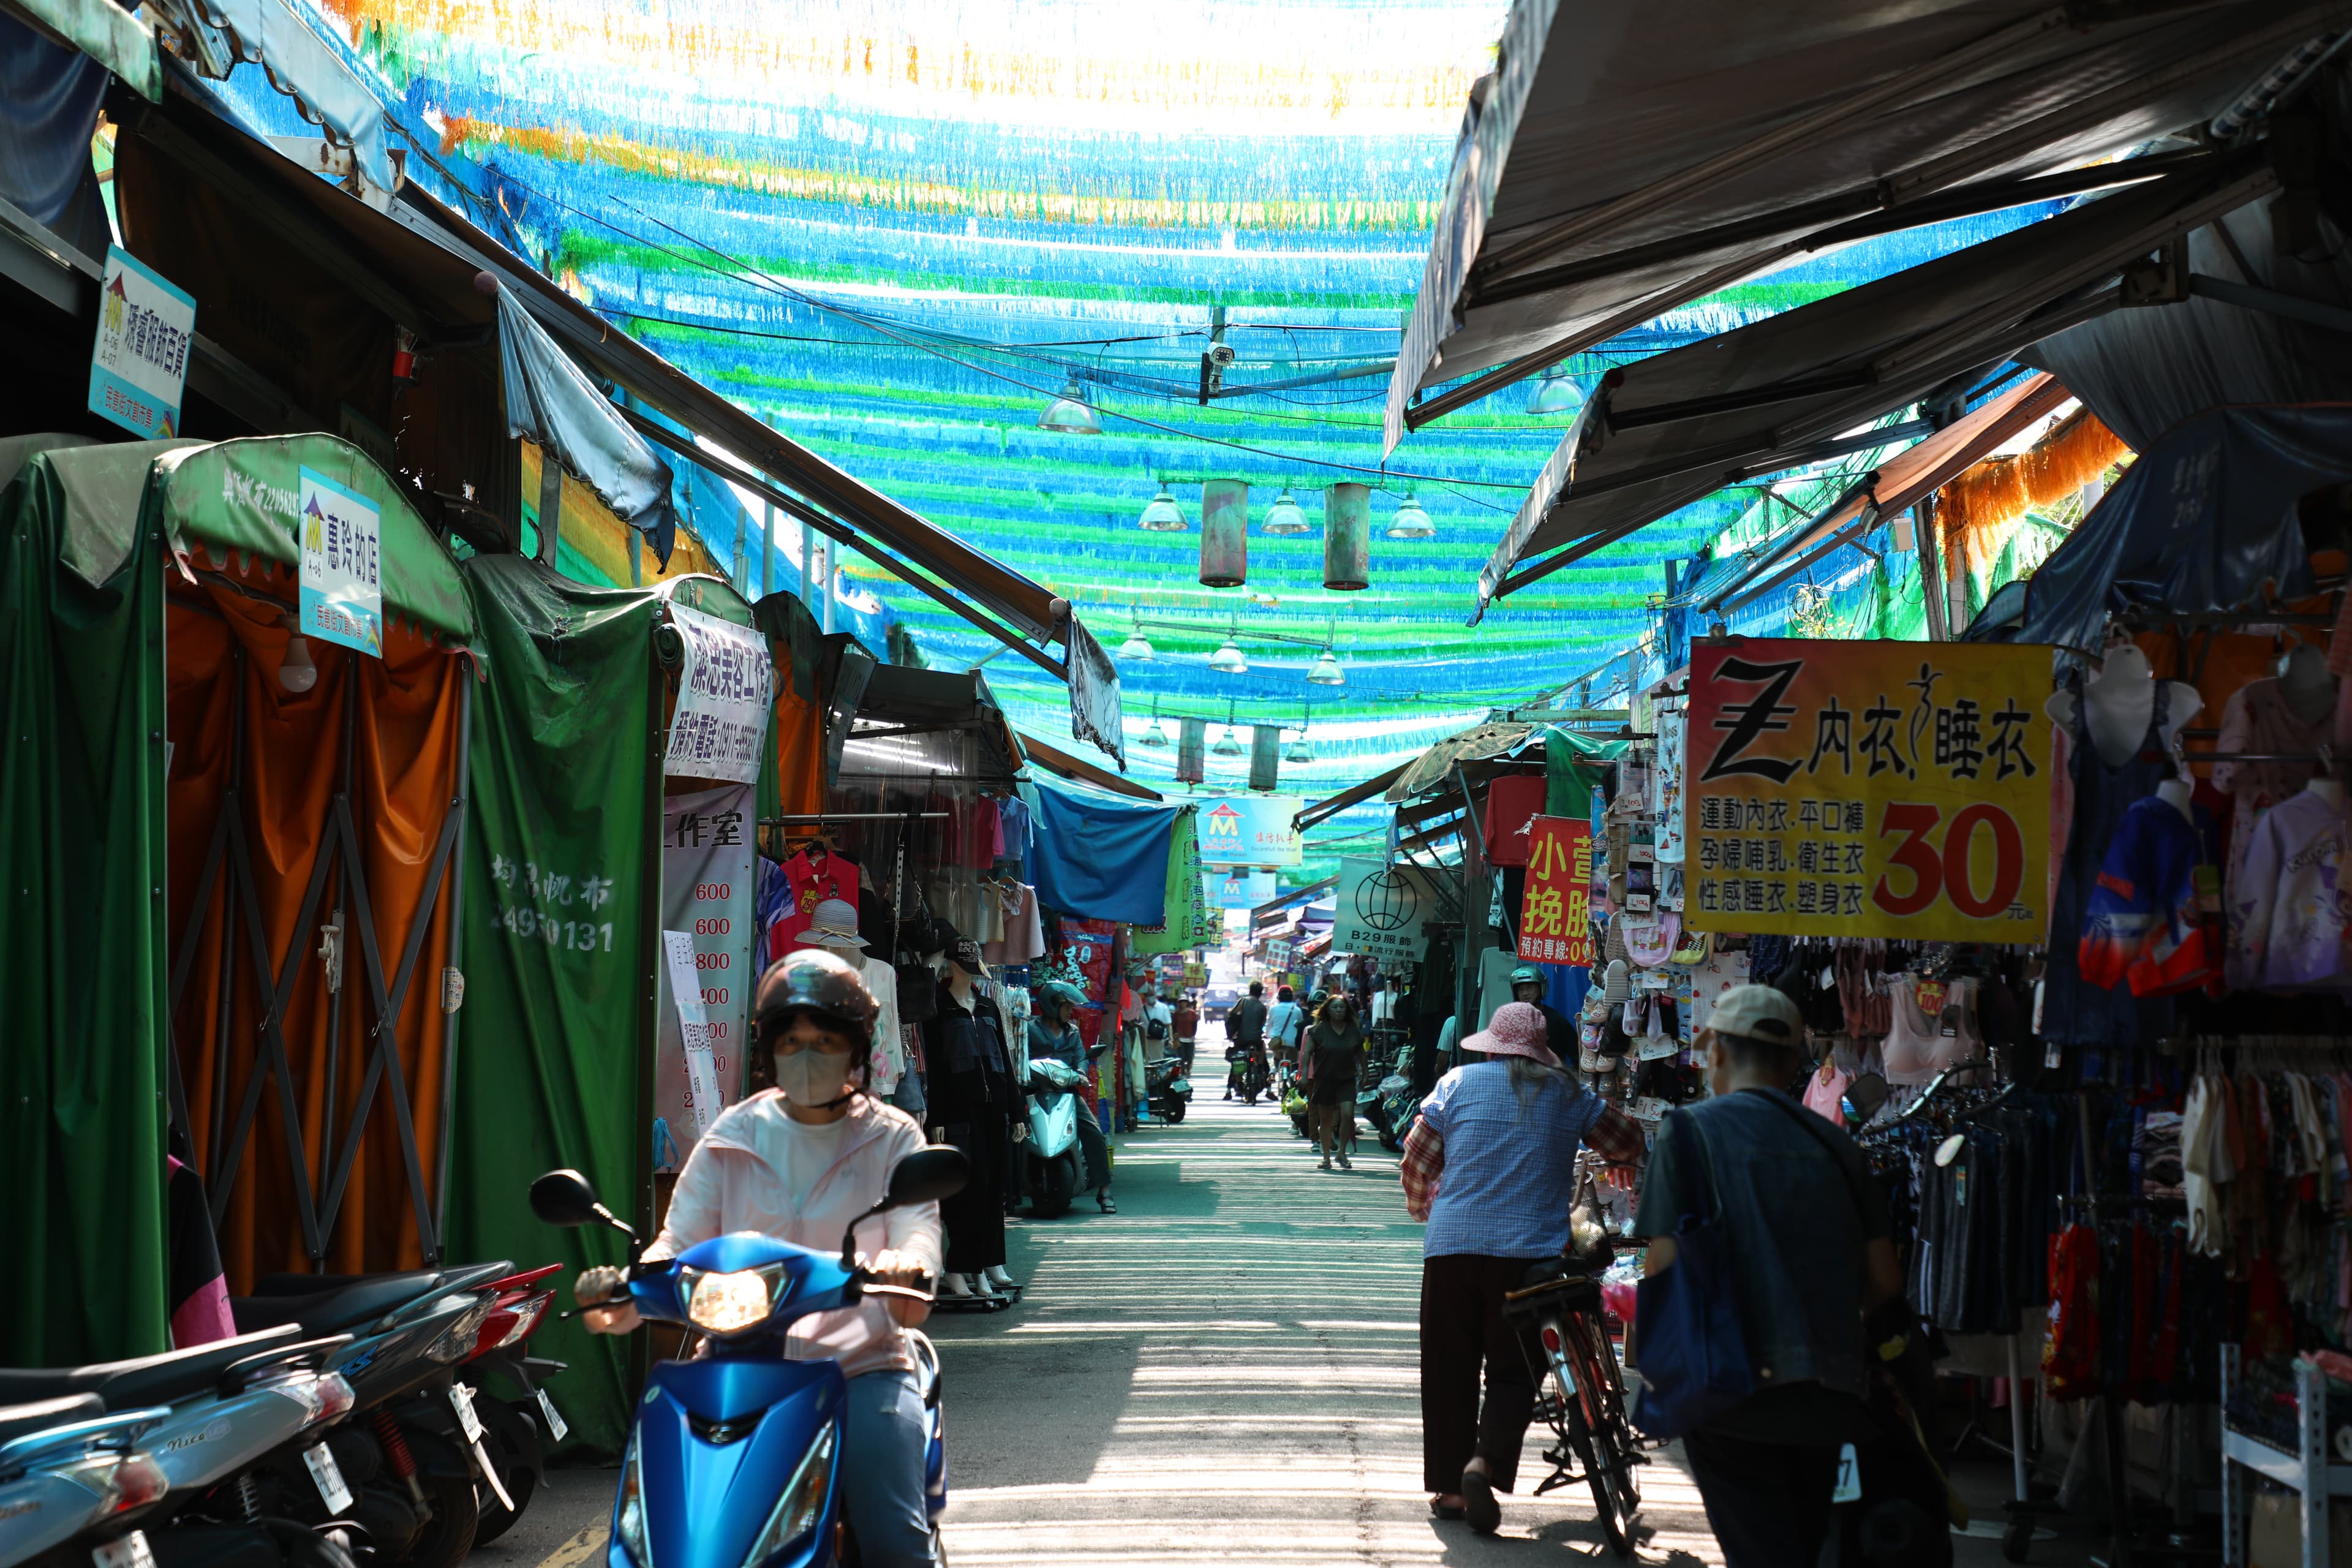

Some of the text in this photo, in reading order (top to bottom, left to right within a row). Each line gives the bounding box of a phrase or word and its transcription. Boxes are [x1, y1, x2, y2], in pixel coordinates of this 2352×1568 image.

[103, 333, 118, 350] A-06
[101, 353, 116, 367] A-07
[105, 385, 153, 429] 民意街文創市集
[328, 513, 377, 588] 惠玲的店
[1872, 801, 2025, 919] 30
[695, 883, 731, 901] 600
[695, 918, 731, 936] 600
[1351, 930, 1412, 946] B29服飾
[695, 953, 731, 970] 800
[1920, 993, 1944, 1012] 100
[707, 1022, 728, 1039] 00
